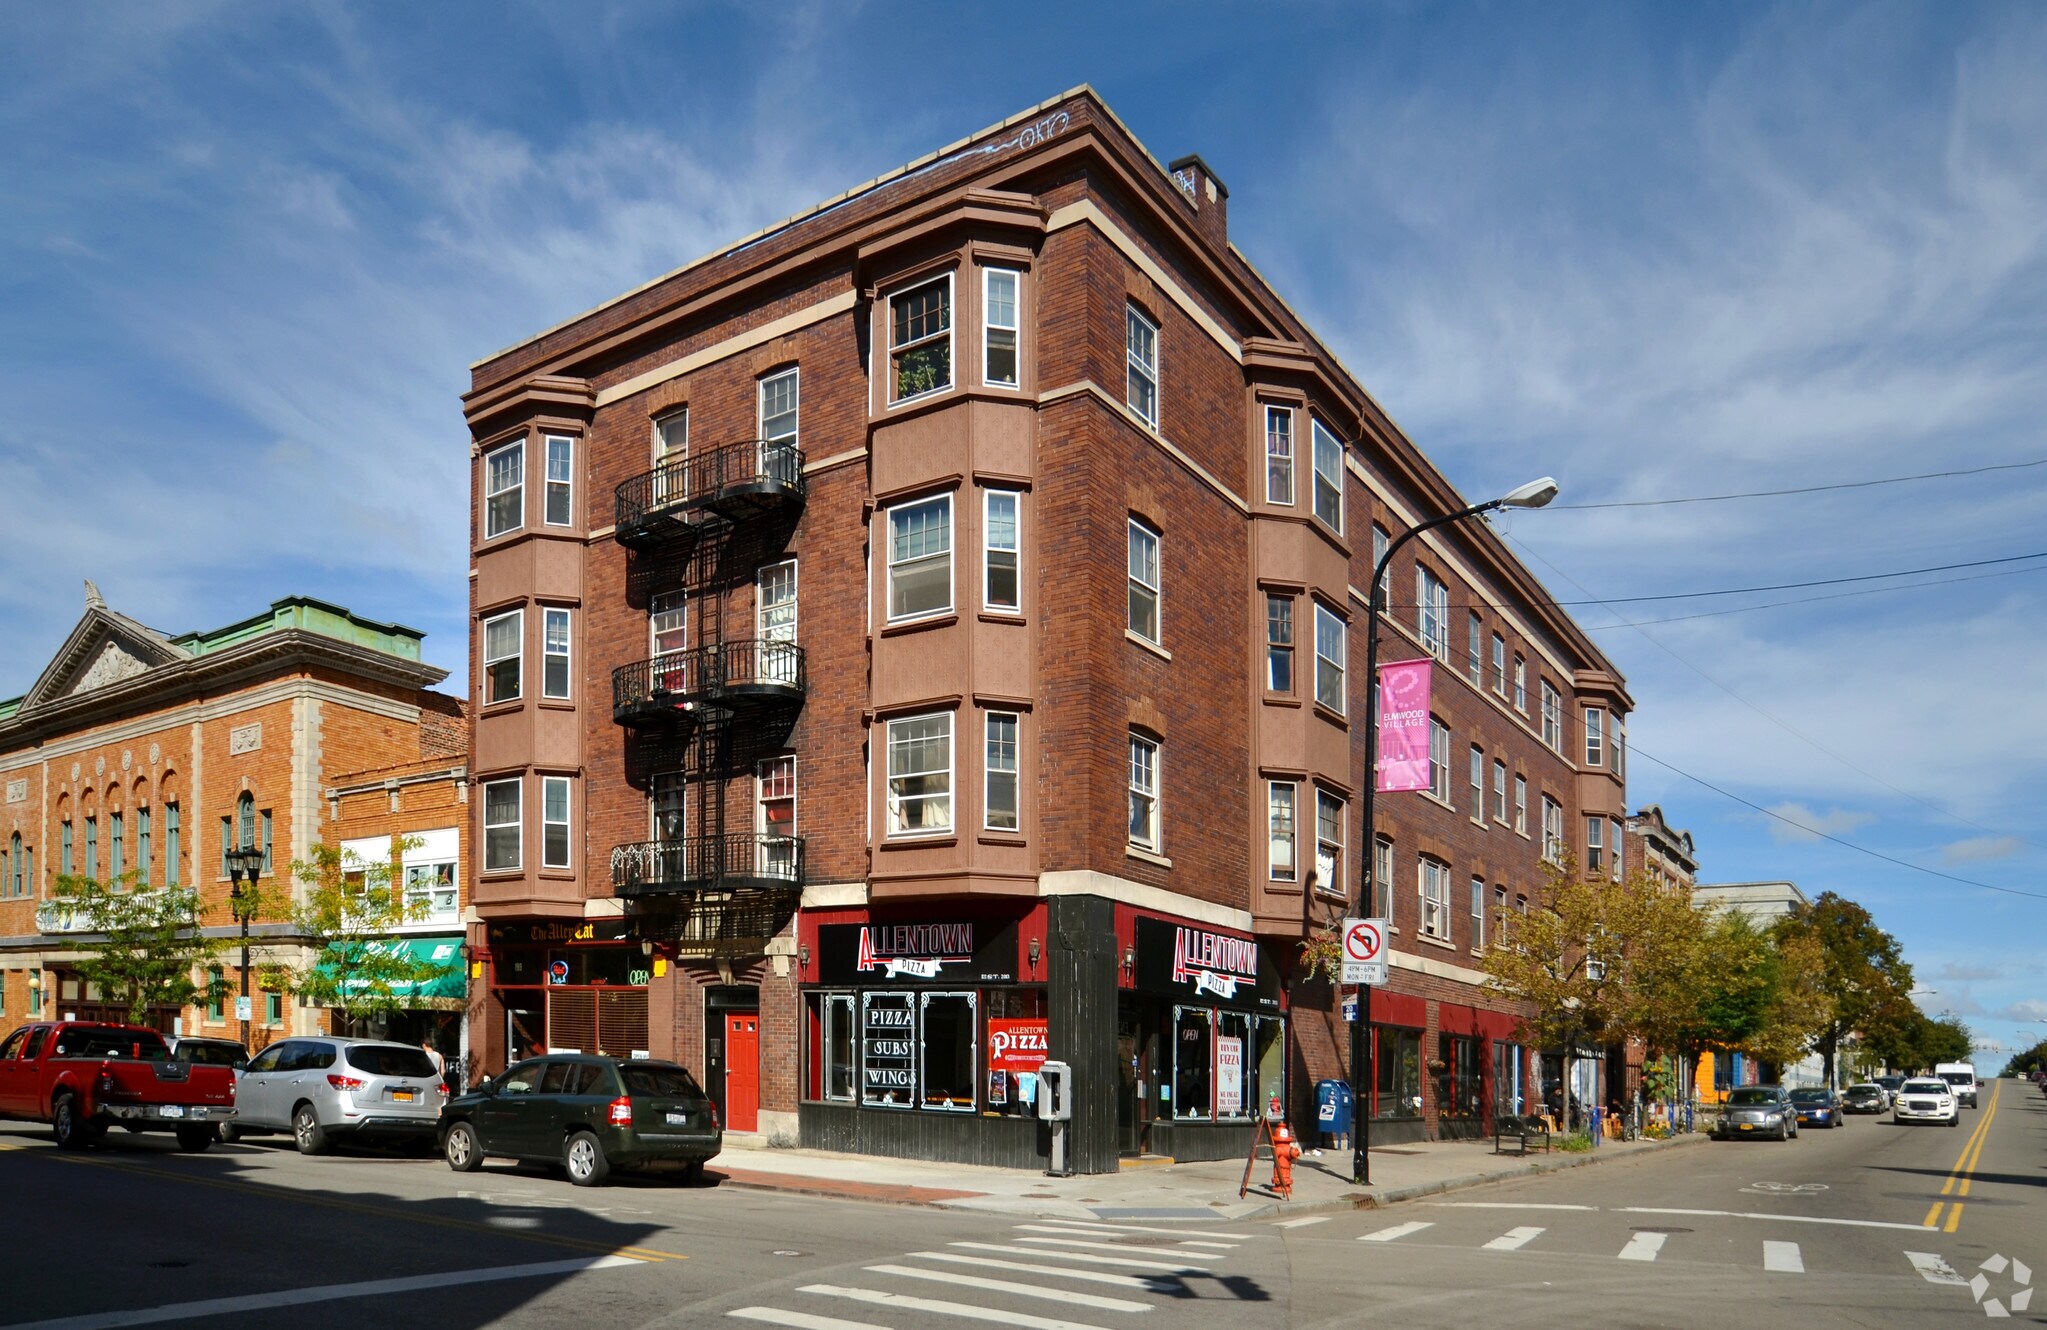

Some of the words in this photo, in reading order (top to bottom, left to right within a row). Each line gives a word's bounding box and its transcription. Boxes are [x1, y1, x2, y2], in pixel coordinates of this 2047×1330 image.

[1383, 709, 1424, 721] ELMWOOD
[1383, 718, 1424, 729] VILLAGE
[530, 926, 547, 941] The
[548, 922, 574, 943] Alley
[574, 922, 594, 940] Cat
[857, 923, 973, 971] ALLENTOWN
[1172, 926, 1257, 984] ALLENTOWN
[902, 958, 927, 975] PIZZA
[1207, 974, 1226, 993] PIZZA
[871, 1010, 914, 1025] PIZZA
[1008, 1026, 1049, 1035] ALLENTOWN
[1182, 1029, 1199, 1041] OPEN
[874, 1041, 909, 1055] SUBS
[990, 1031, 1048, 1060] PIZZA
[1220, 1054, 1240, 1065] PIZZA
[868, 1070, 917, 1086] WINGS
